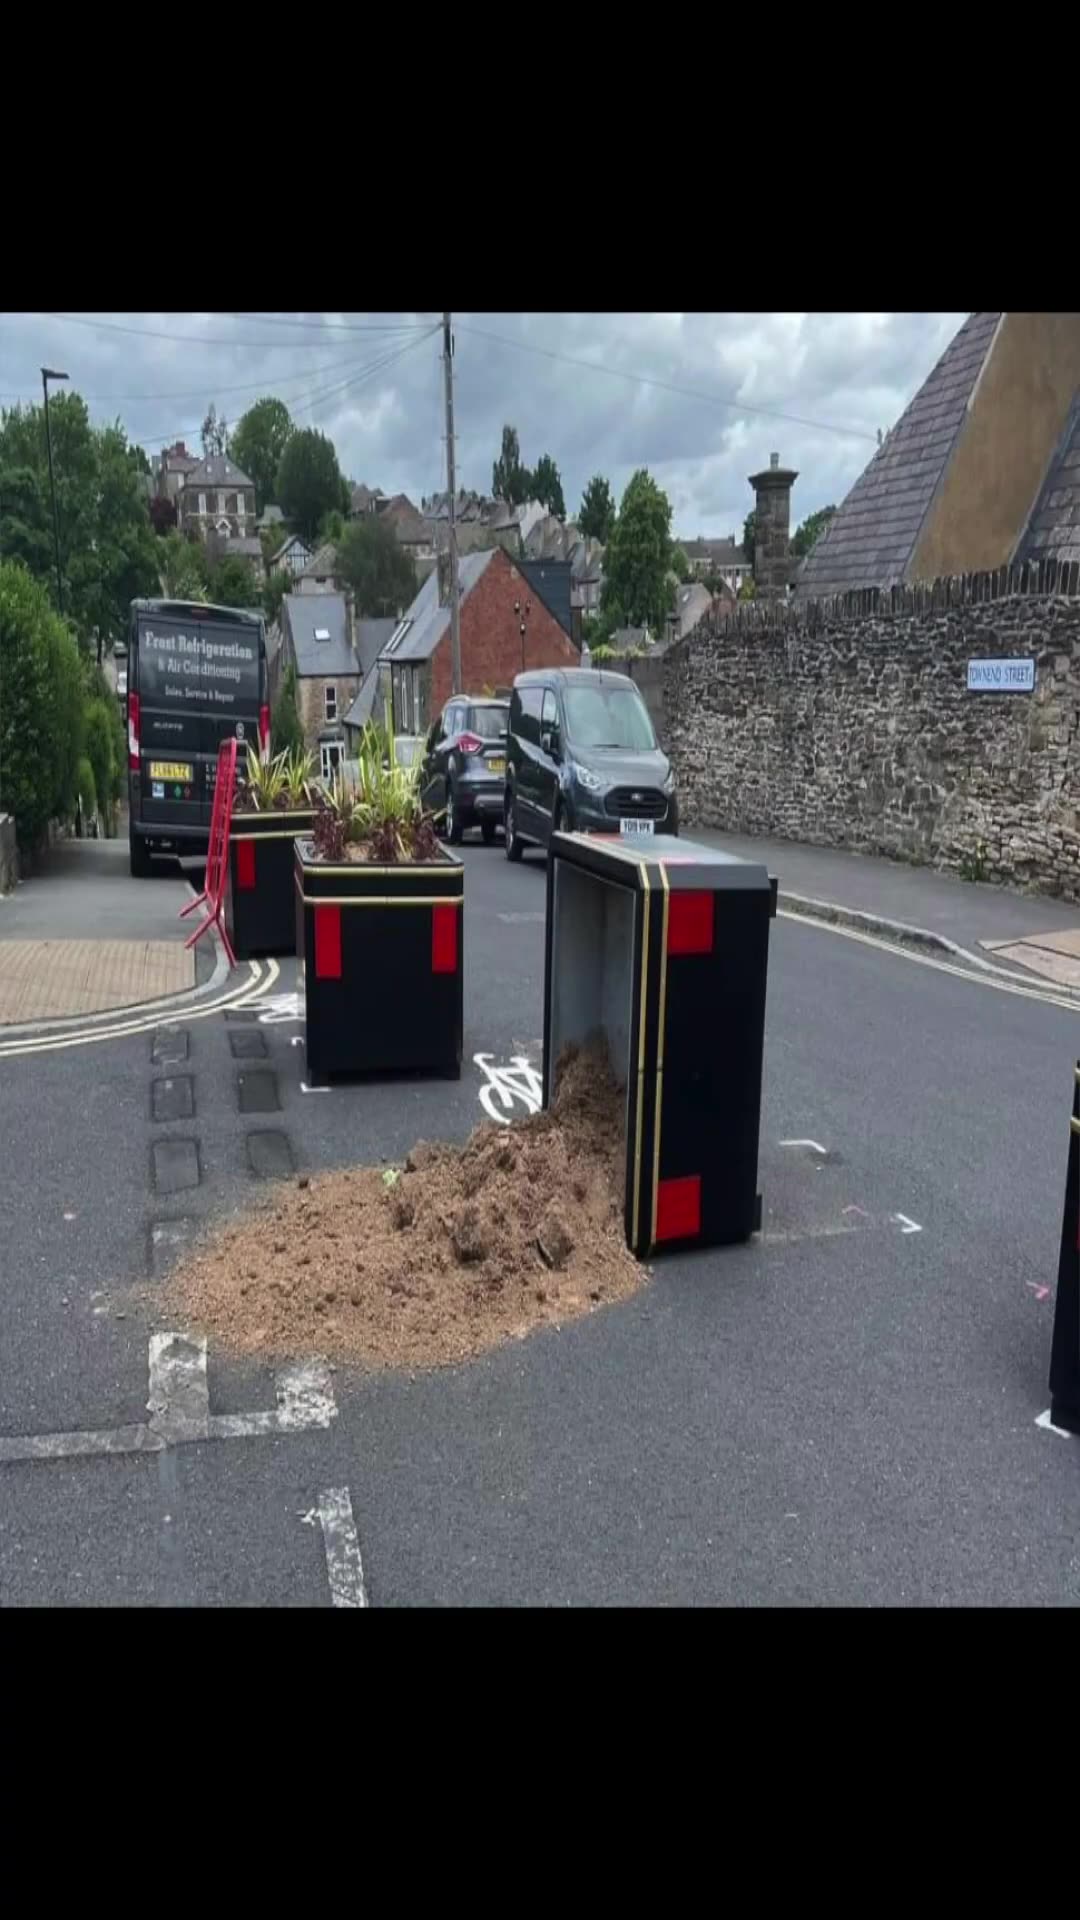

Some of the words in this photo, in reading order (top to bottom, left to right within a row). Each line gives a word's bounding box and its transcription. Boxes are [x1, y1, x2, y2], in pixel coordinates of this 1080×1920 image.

[178, 635, 253, 659] Refrigeration
[167, 658, 181, 673] Air
[183, 660, 241, 683] Conditioning
[970, 665, 1002, 682] TOWNEND
[1005, 665, 1030, 683] STREET
